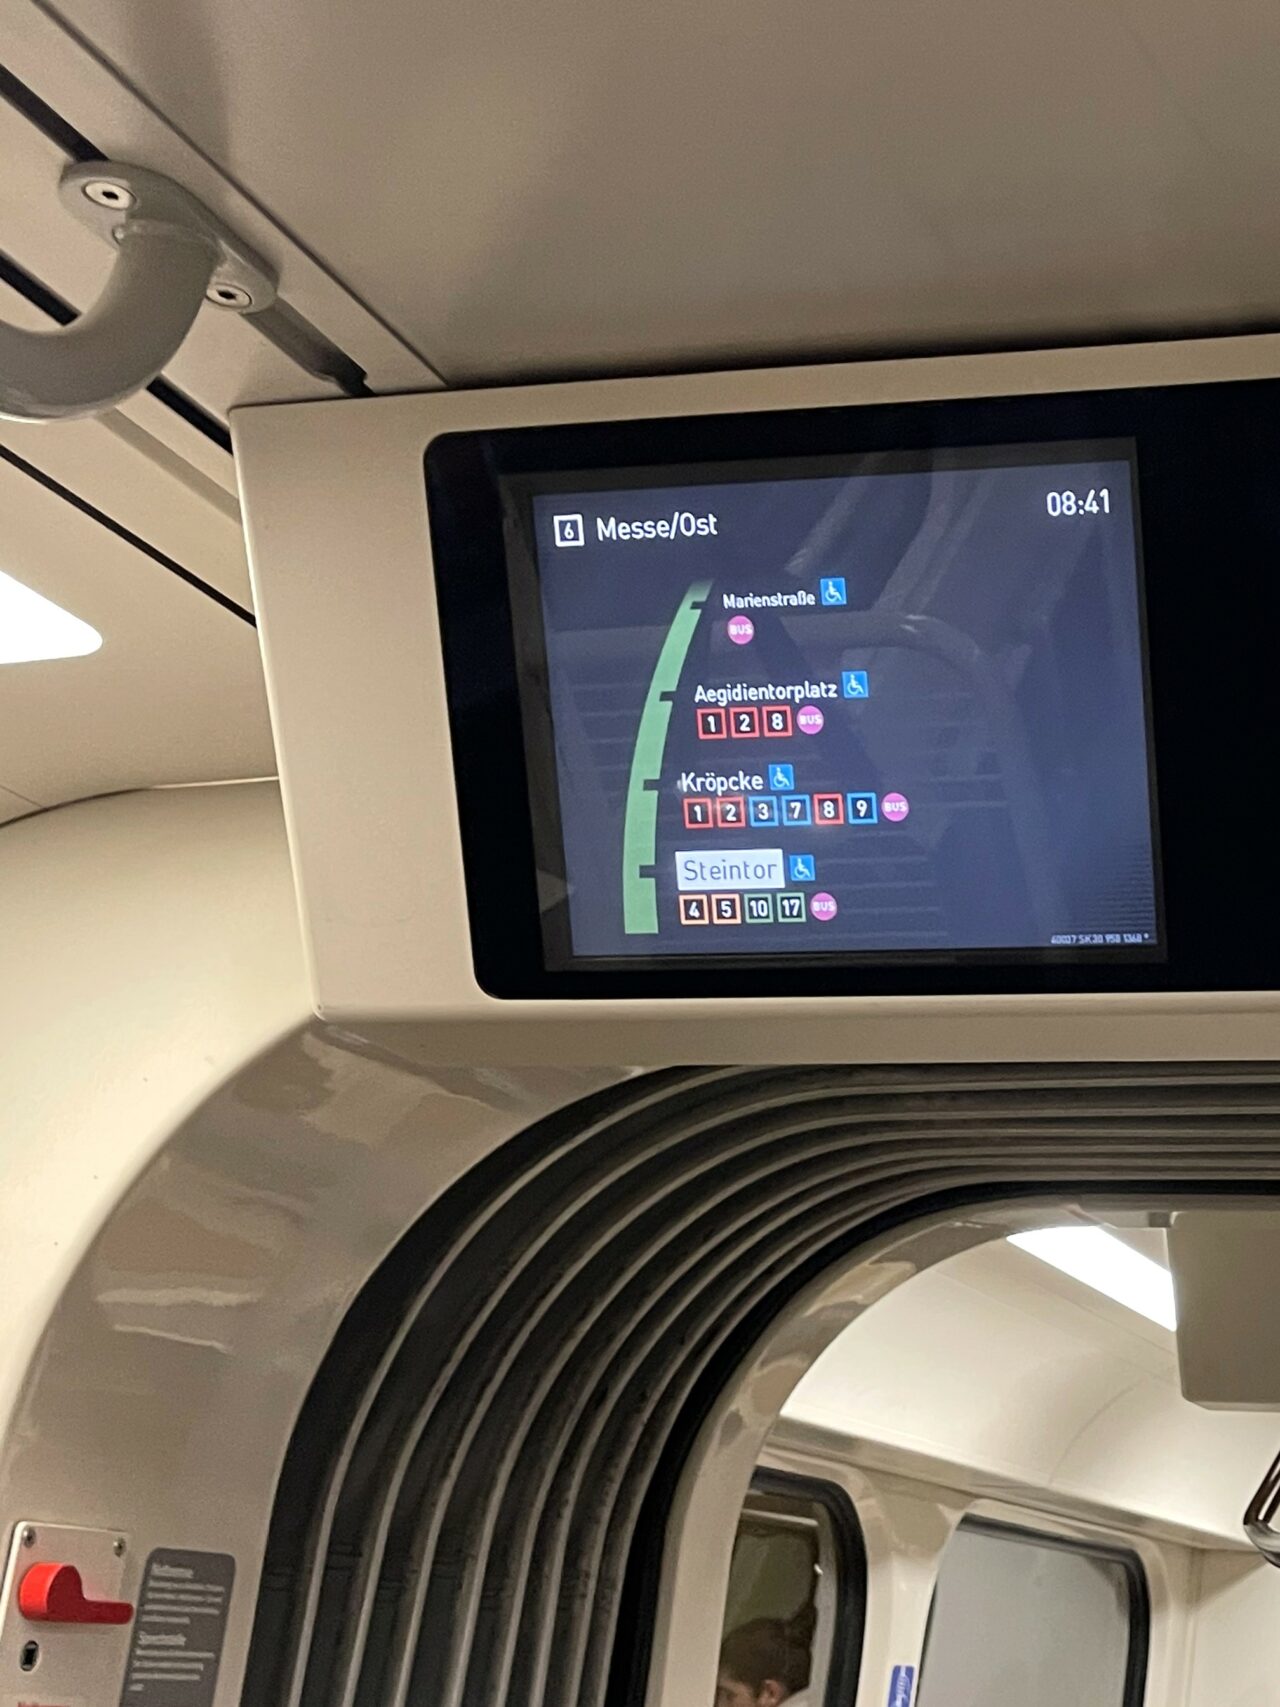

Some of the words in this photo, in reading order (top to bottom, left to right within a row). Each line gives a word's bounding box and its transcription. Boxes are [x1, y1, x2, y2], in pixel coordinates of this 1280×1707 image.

[1046, 488, 1110, 517] 08:41
[596, 511, 718, 542] Messe/Ost
[722, 590, 816, 609] Marienstraße
[728, 623, 754, 635] BUS
[694, 681, 838, 707] Aegidientorplatz
[706, 715, 717, 733] 1
[739, 714, 751, 732] 2
[771, 712, 784, 731] 8
[798, 713, 824, 726] BUS
[680, 770, 765, 797] Kröpcke
[693, 805, 703, 822] 1
[725, 803, 738, 822] 2
[757, 802, 770, 820] 3
[788, 801, 802, 819] 7
[822, 800, 835, 818] 8
[856, 799, 868, 818] 9
[882, 801, 909, 813] BUS
[683, 858, 778, 882] Steintor
[688, 901, 701, 919] 4
[720, 900, 732, 918] 5
[749, 899, 768, 918] 10
[782, 898, 801, 917] 17
[811, 901, 836, 913] BUS
